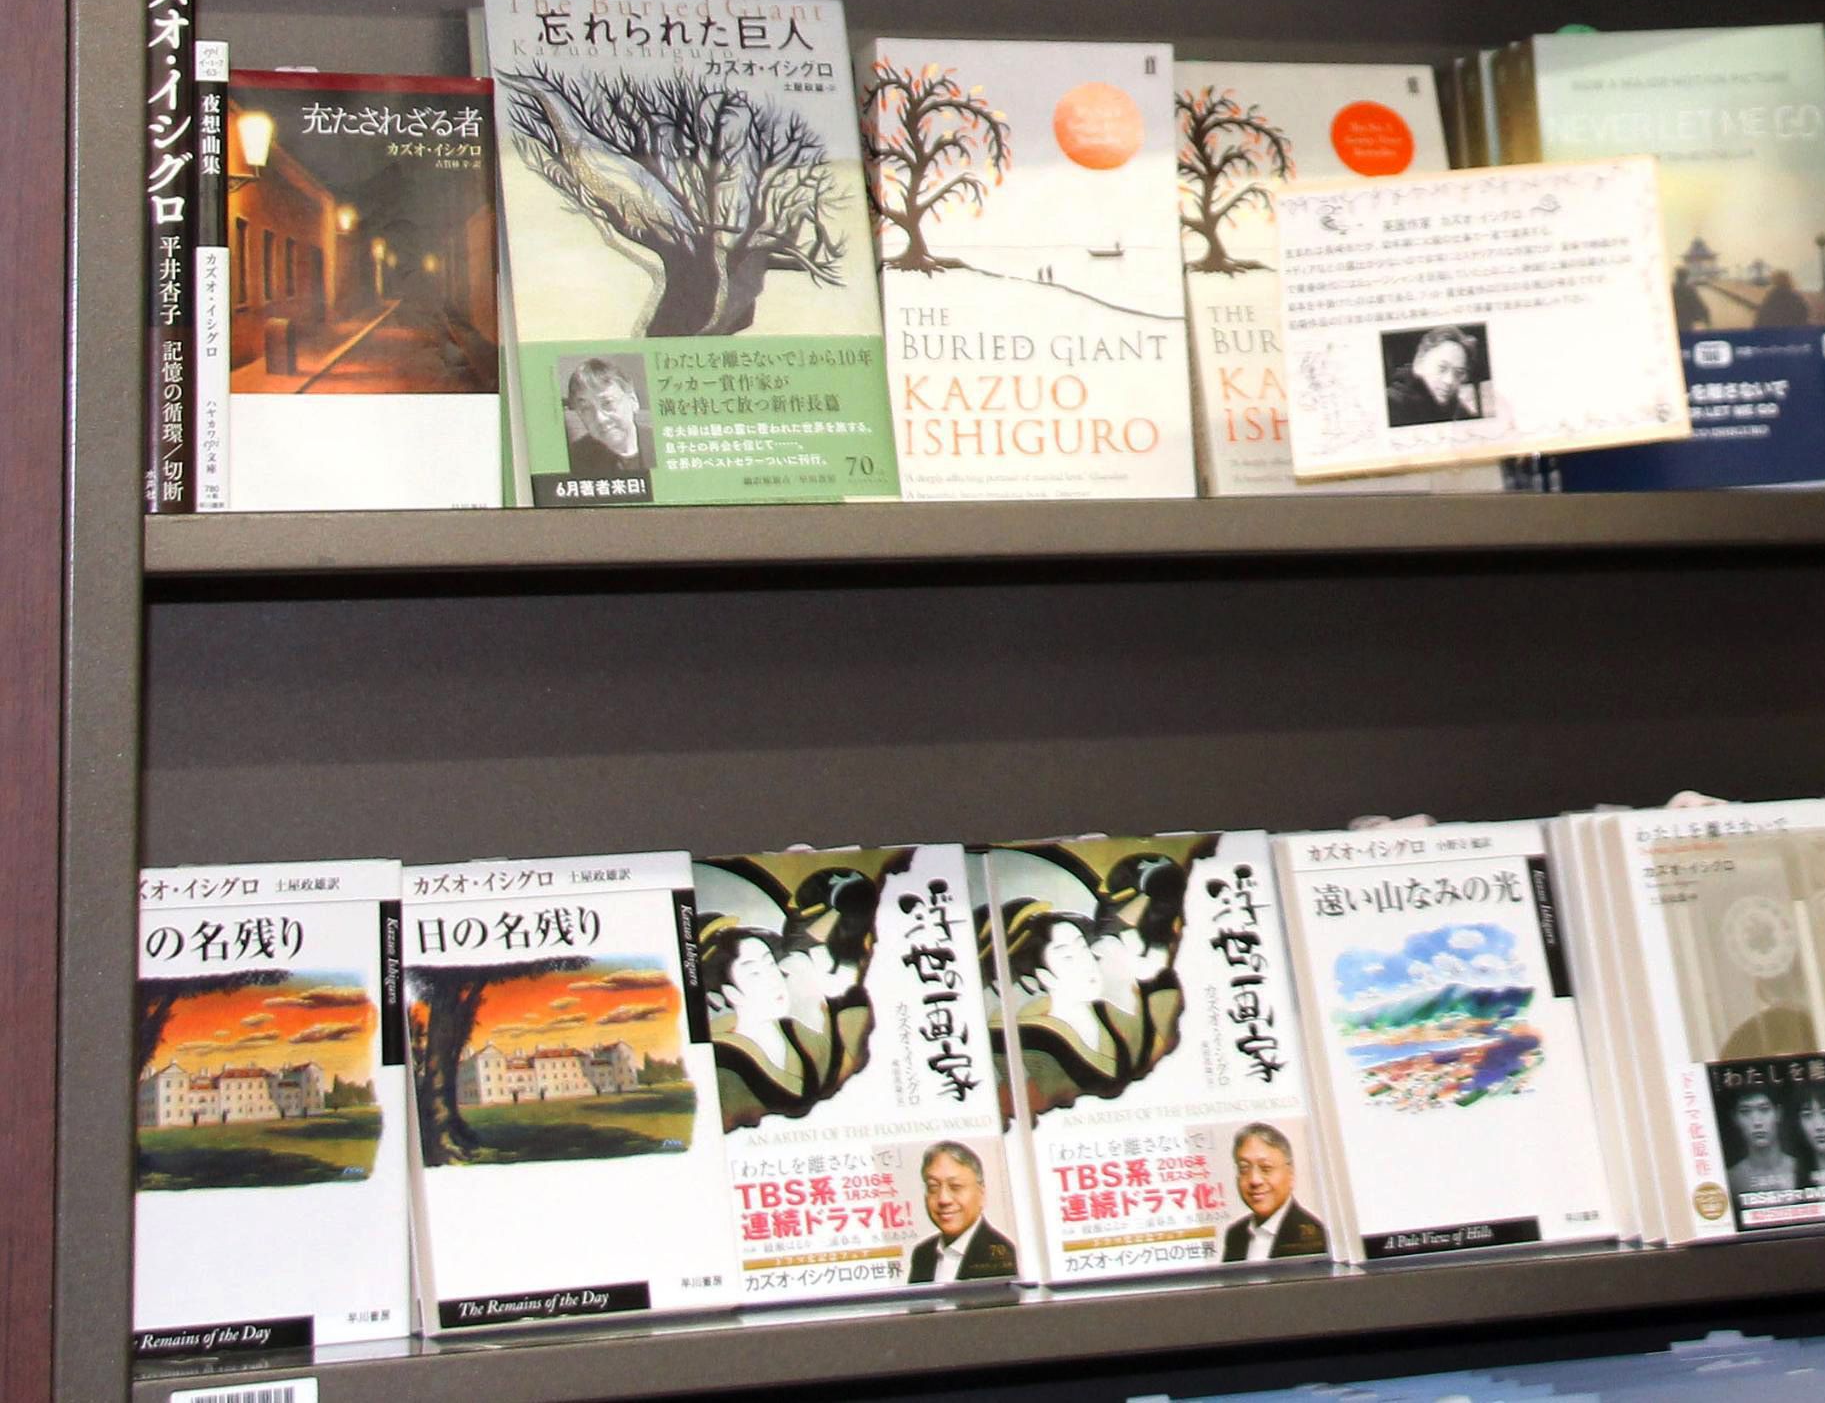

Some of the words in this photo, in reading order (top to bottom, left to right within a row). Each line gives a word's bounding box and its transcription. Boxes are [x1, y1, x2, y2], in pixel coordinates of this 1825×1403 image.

[536, 9, 815, 51] 忘れられた巨人
[201, 93, 221, 175] 夜想曲集
[301, 102, 483, 138] 充たされざる者
[387, 142, 482, 158] カズオ・イシグロ
[159, 235, 182, 325] 平井杏子
[205, 253, 219, 357] カズオ・イシグロ
[900, 306, 950, 328] THE
[1208, 305, 1255, 323] THE
[902, 332, 1036, 363] BURIED
[1050, 330, 1169, 367] GIANT
[905, 374, 1088, 412] KAZUO
[904, 417, 1160, 458] ISHIGURO
[413, 870, 554, 896] カズオ・イシグロ
[1312, 869, 1524, 918] 遠い山なみの光
[145, 917, 305, 962] の名残り
[418, 905, 602, 954] 日の名残り
[734, 1175, 837, 1210] TBS系
[1053, 1157, 1151, 1193] TBS系
[744, 1260, 904, 1293] カズオ・イシグロの世界
[459, 1301, 484, 1319] The
[487, 1297, 543, 1315] Remains
[545, 1293, 558, 1313] of
[559, 1292, 579, 1308] the
[581, 1289, 609, 1308] Day
[140, 1333, 200, 1350] Remains
[202, 1328, 217, 1347] of
[218, 1326, 238, 1344] the
[242, 1324, 272, 1343] Day
